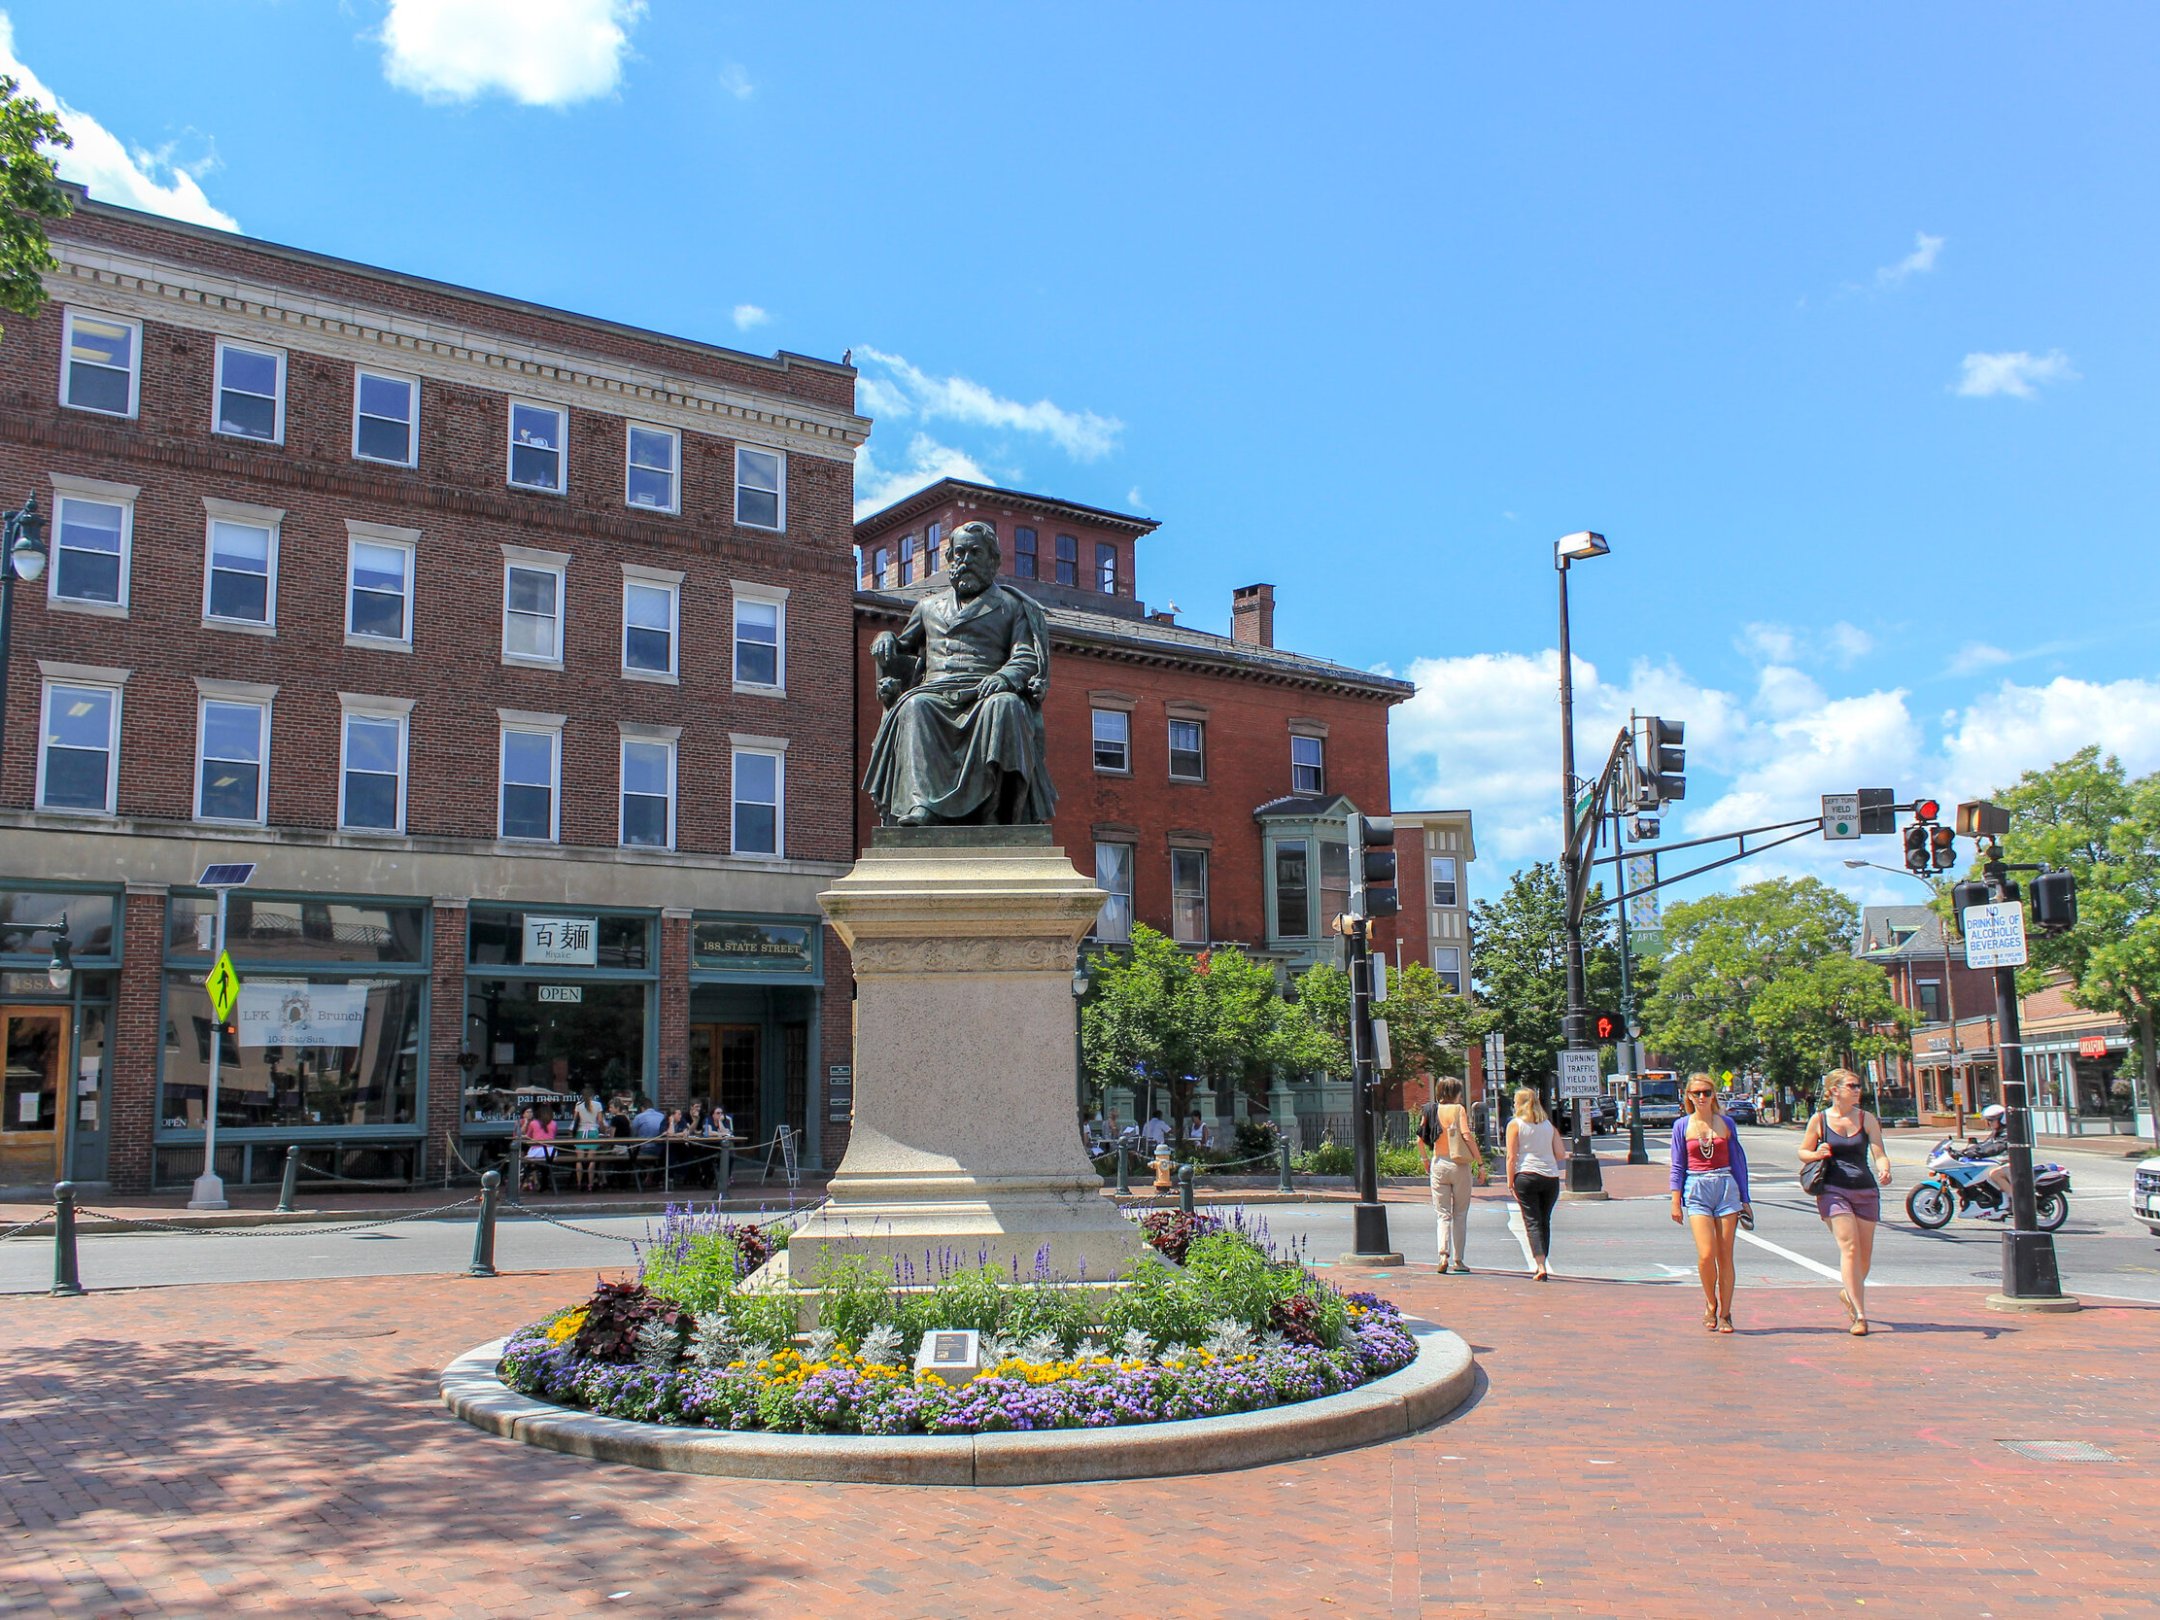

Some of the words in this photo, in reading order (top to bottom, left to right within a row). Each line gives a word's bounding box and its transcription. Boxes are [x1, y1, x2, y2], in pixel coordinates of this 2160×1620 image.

[1832, 805, 1851, 813] YIELD
[1985, 906, 1999, 917] NO
[1967, 916, 2006, 929] DRINKING
[2008, 914, 2020, 925] OF
[1636, 931, 1660, 943] ARTS
[1971, 926, 2018, 940] ALCOHOLIC
[724, 942, 758, 952] STATE
[760, 943, 800, 953] STREET
[1970, 937, 2021, 951] BEVERAGES
[545, 950, 572, 962] Miyake
[540, 987, 580, 1001] OPEN
[243, 1010, 271, 1021] LFK
[317, 1010, 362, 1021] Brunch
[1566, 1054, 1596, 1062] TURNING
[1567, 1075, 1587, 1083] YIELD
[1566, 1085, 1599, 1093] PEDESTRIANS
[161, 1117, 187, 1127] OPEN
